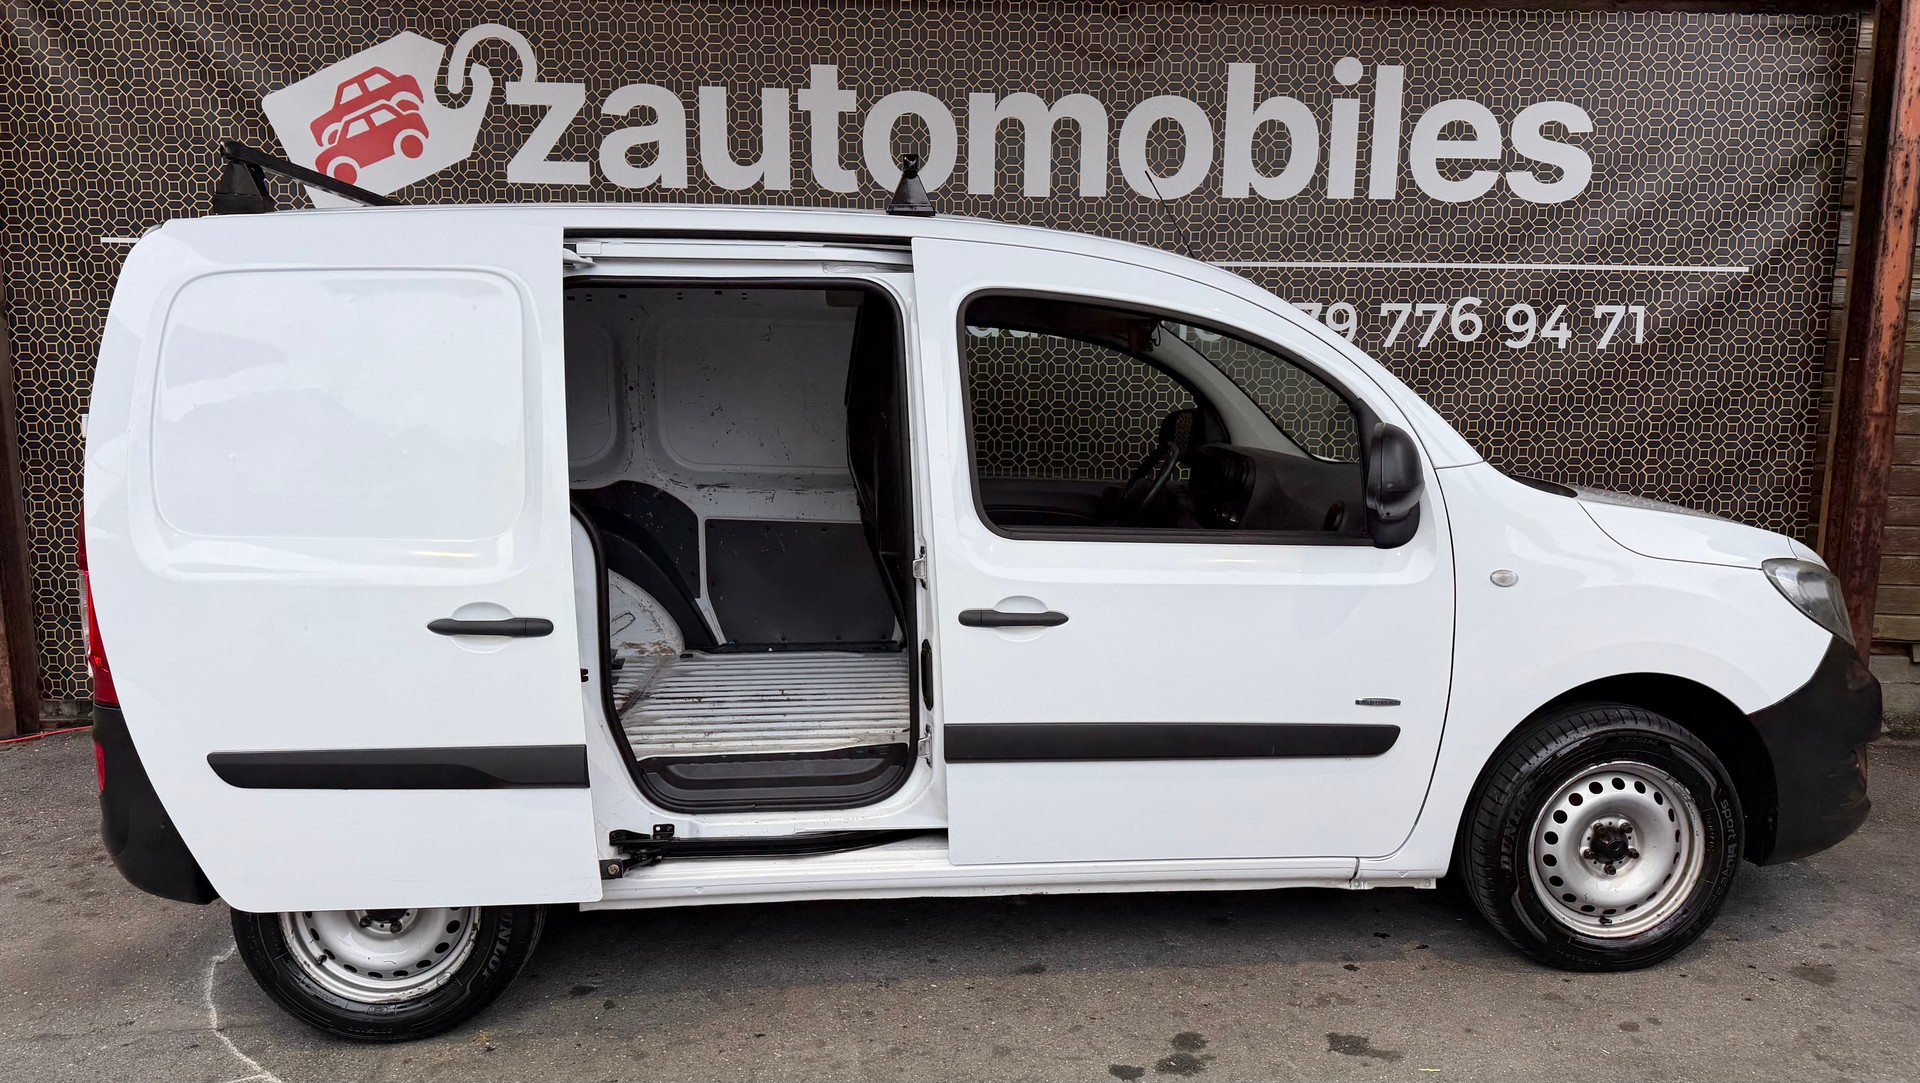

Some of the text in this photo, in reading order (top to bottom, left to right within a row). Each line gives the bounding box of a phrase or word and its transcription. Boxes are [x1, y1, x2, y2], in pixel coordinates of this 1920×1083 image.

[505, 57, 1594, 204] zautomobiles
[1380, 297, 1483, 348] 776
[1505, 303, 1572, 349] 94
[1594, 305, 1645, 349] 71
[1720, 798, 1737, 841] sport
[482, 910, 513, 988] UNLOP
